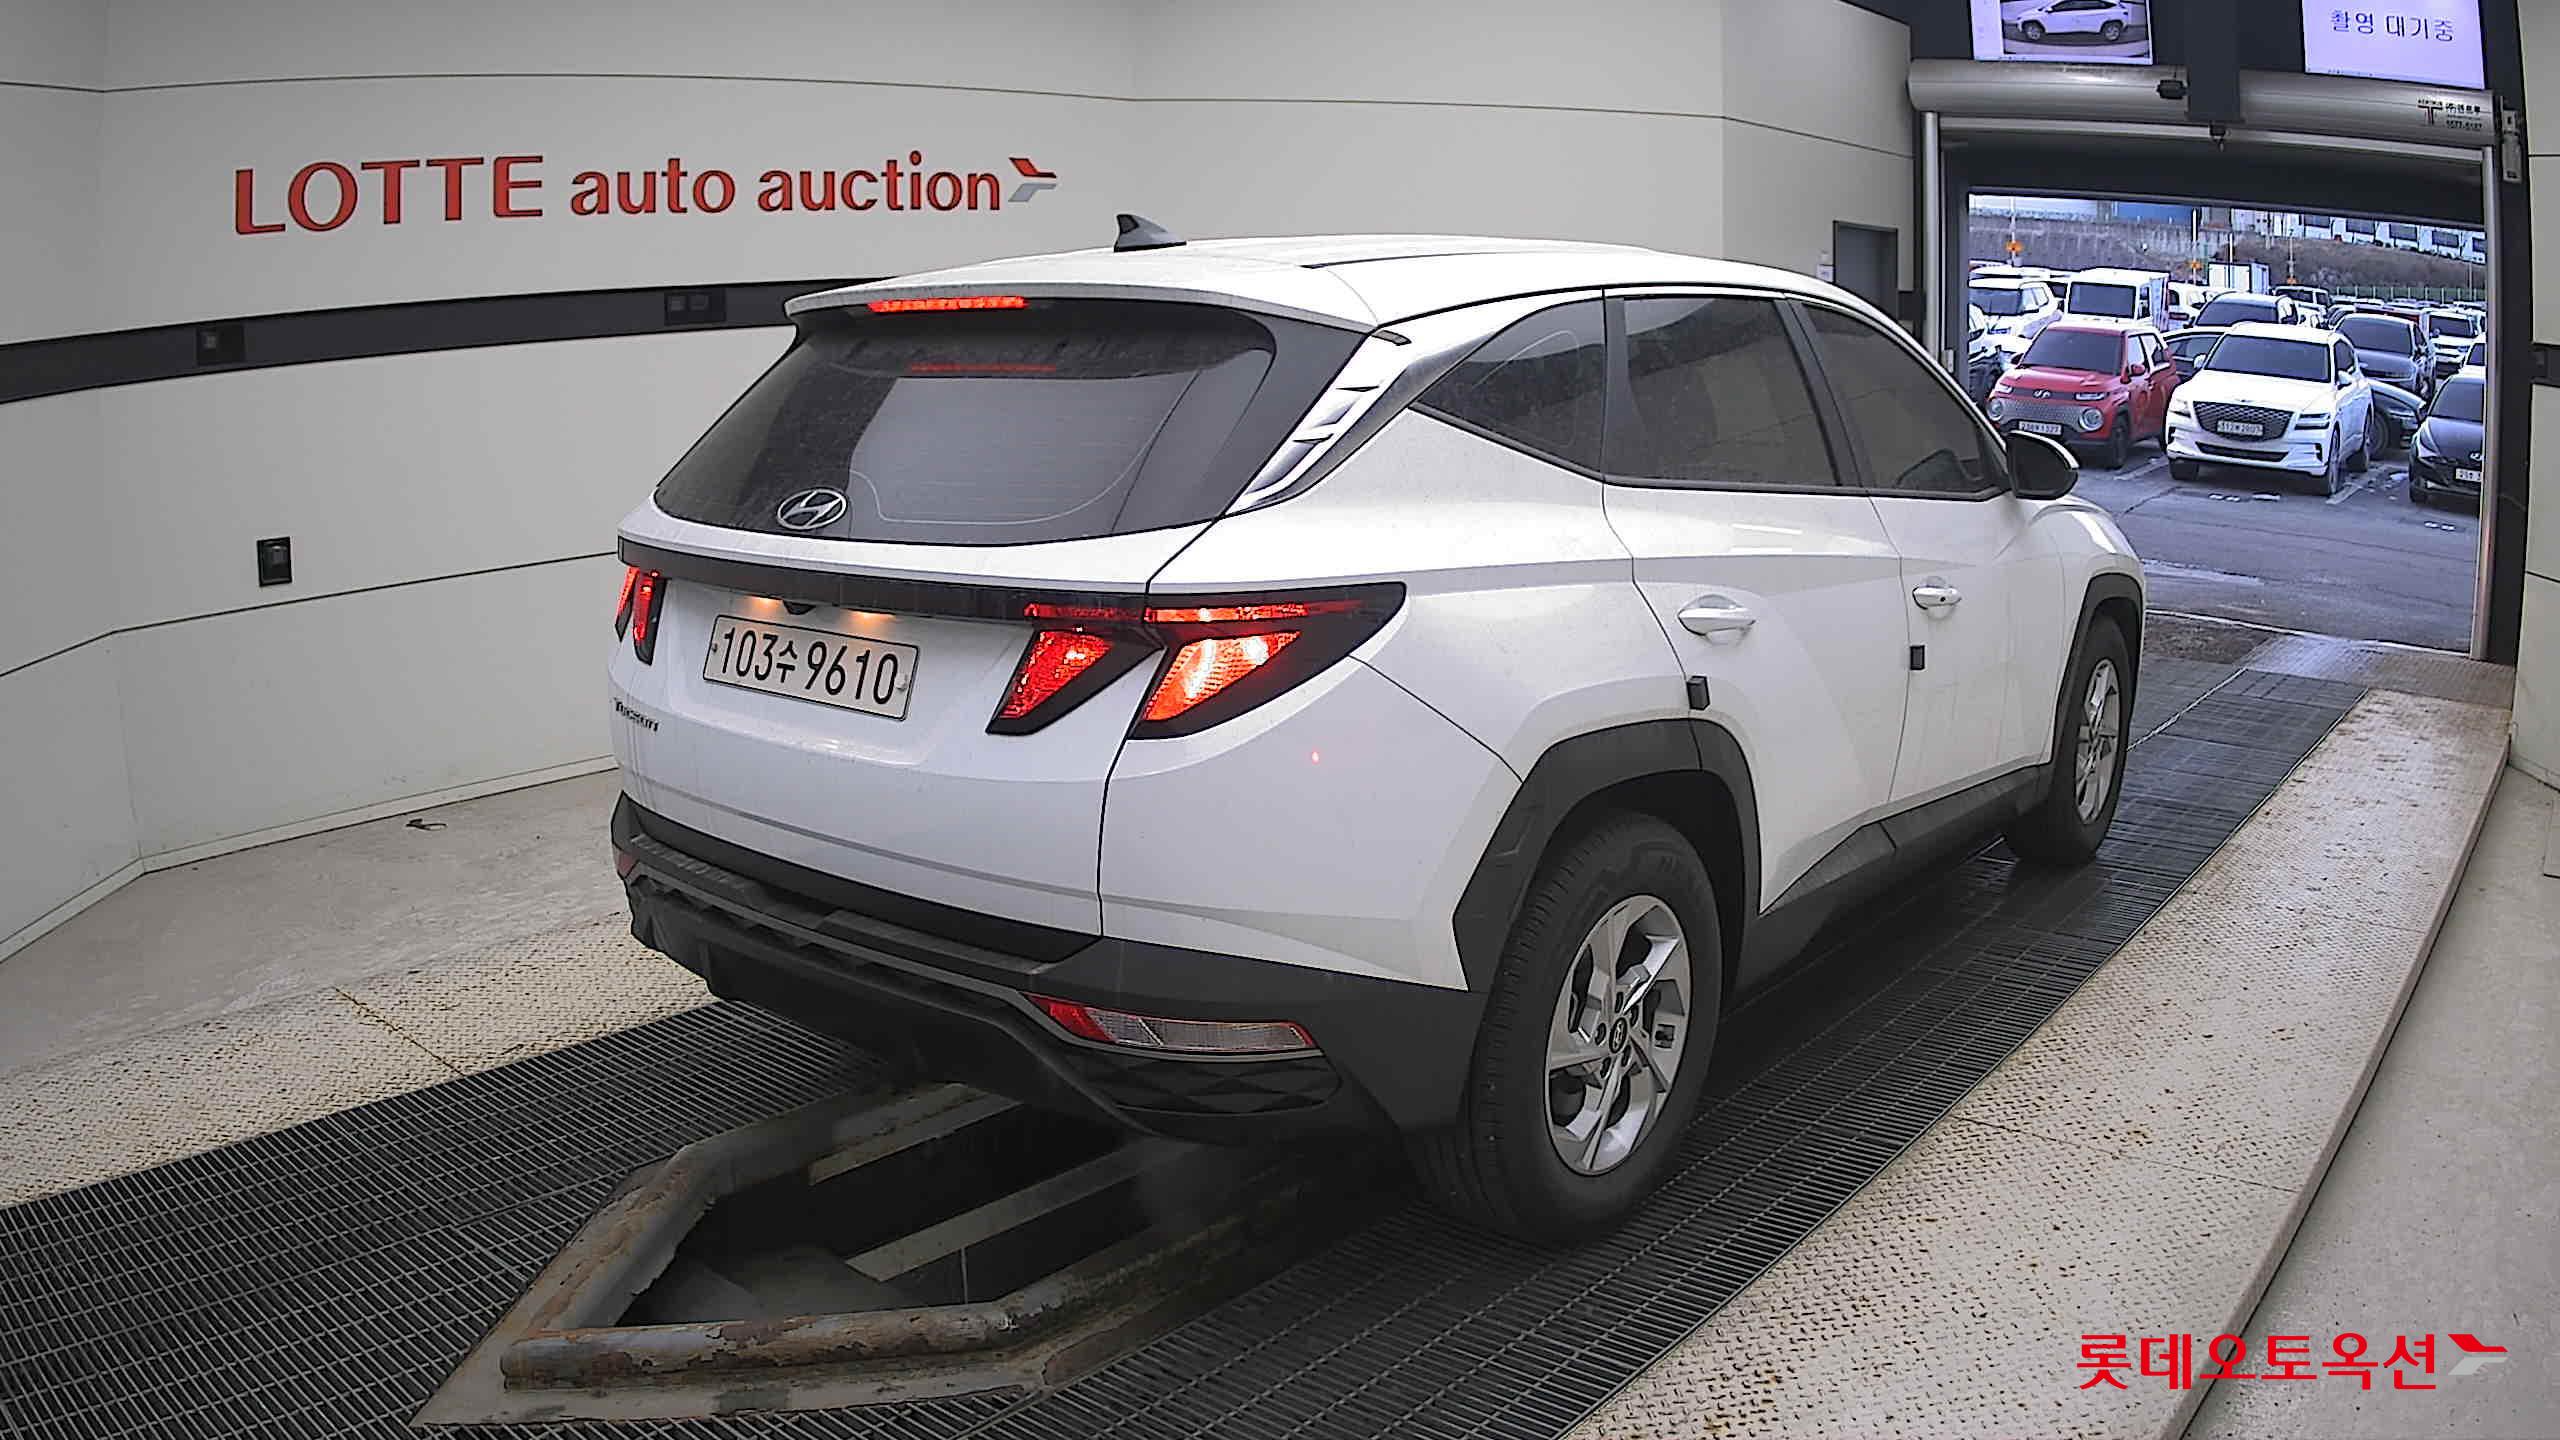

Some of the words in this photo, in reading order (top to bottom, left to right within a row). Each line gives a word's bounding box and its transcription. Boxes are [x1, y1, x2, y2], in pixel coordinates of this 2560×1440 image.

[2329, 10, 2375, 35] 촬영
[2385, 15, 2455, 42] 대기중
[235, 154, 544, 235] LOTTE
[571, 157, 736, 215] auto
[758, 149, 1001, 212] auction
